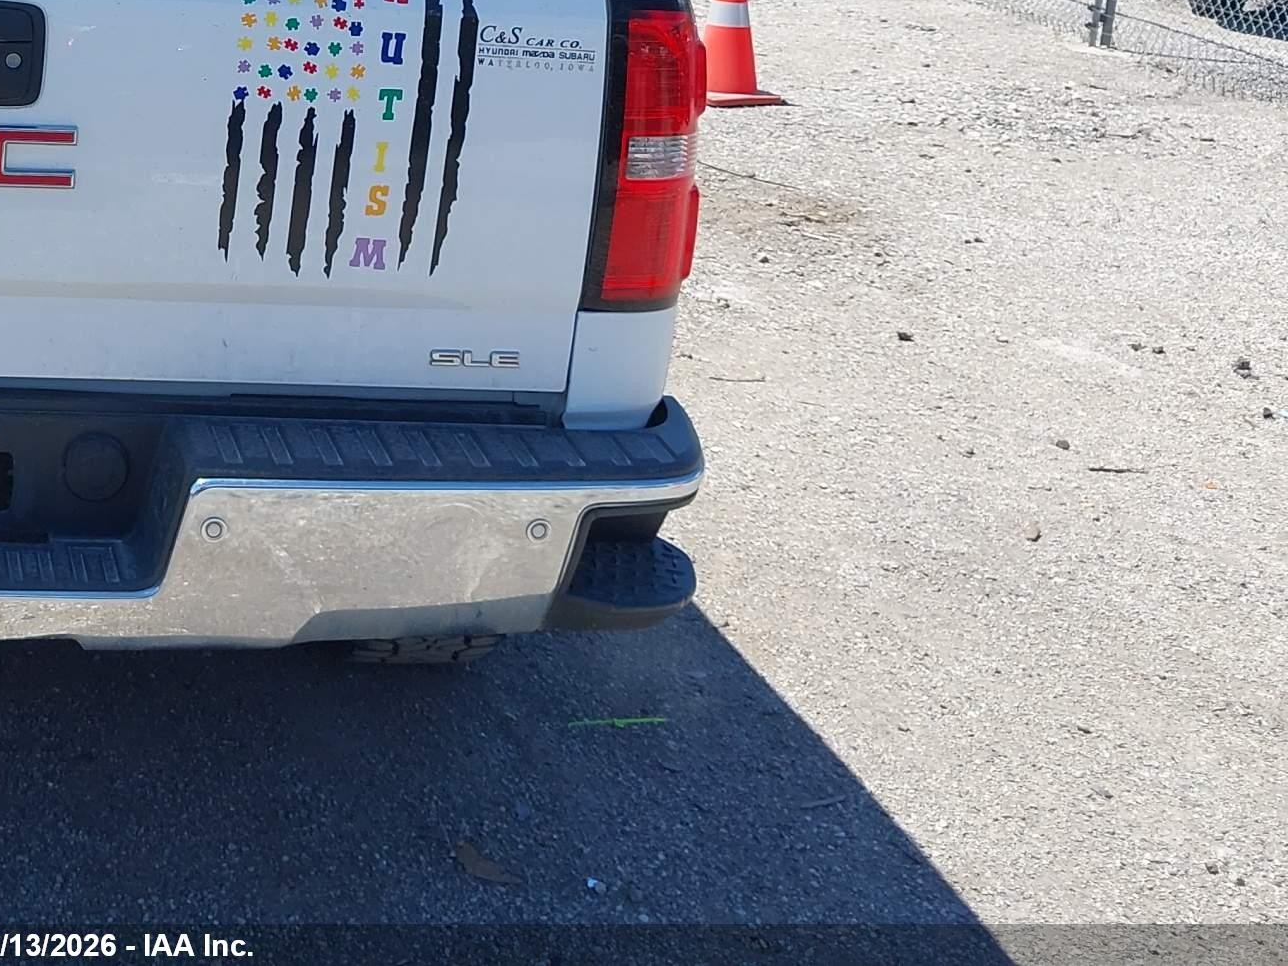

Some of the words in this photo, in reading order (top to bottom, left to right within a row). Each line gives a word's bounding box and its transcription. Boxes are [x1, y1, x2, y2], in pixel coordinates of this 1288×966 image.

[480, 25, 522, 45] C&S
[526, 37, 555, 48] CAR
[560, 39, 582, 50] CO.
[559, 52, 595, 61] SUBARU
[429, 349, 520, 368] SLE
